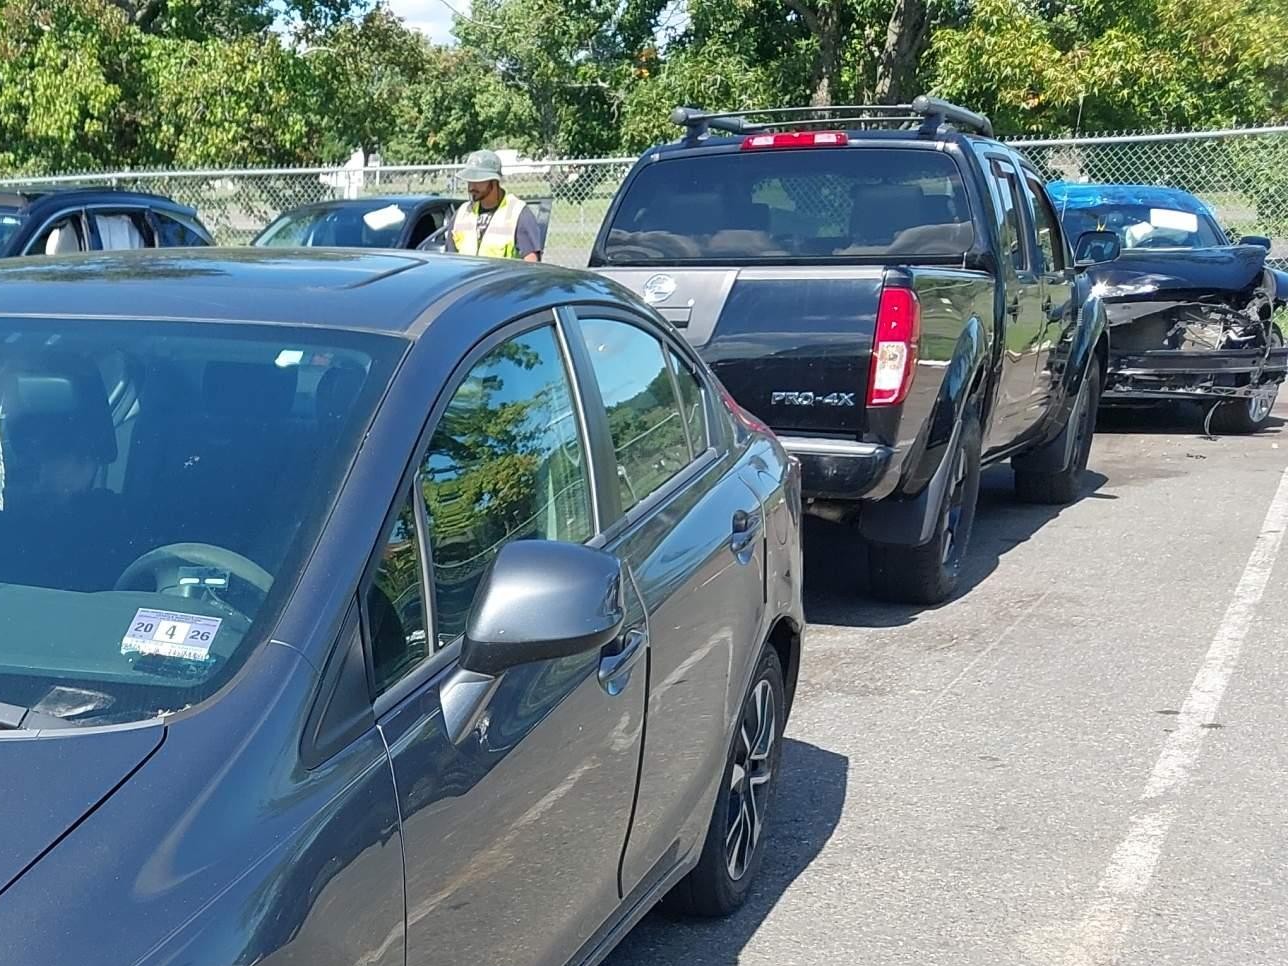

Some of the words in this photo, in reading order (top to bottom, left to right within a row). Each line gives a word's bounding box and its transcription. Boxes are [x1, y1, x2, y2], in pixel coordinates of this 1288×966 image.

[771, 391, 855, 406] PRO-4X
[134, 622, 154, 633] 20
[165, 625, 177, 639] 4
[189, 630, 211, 641] 26
